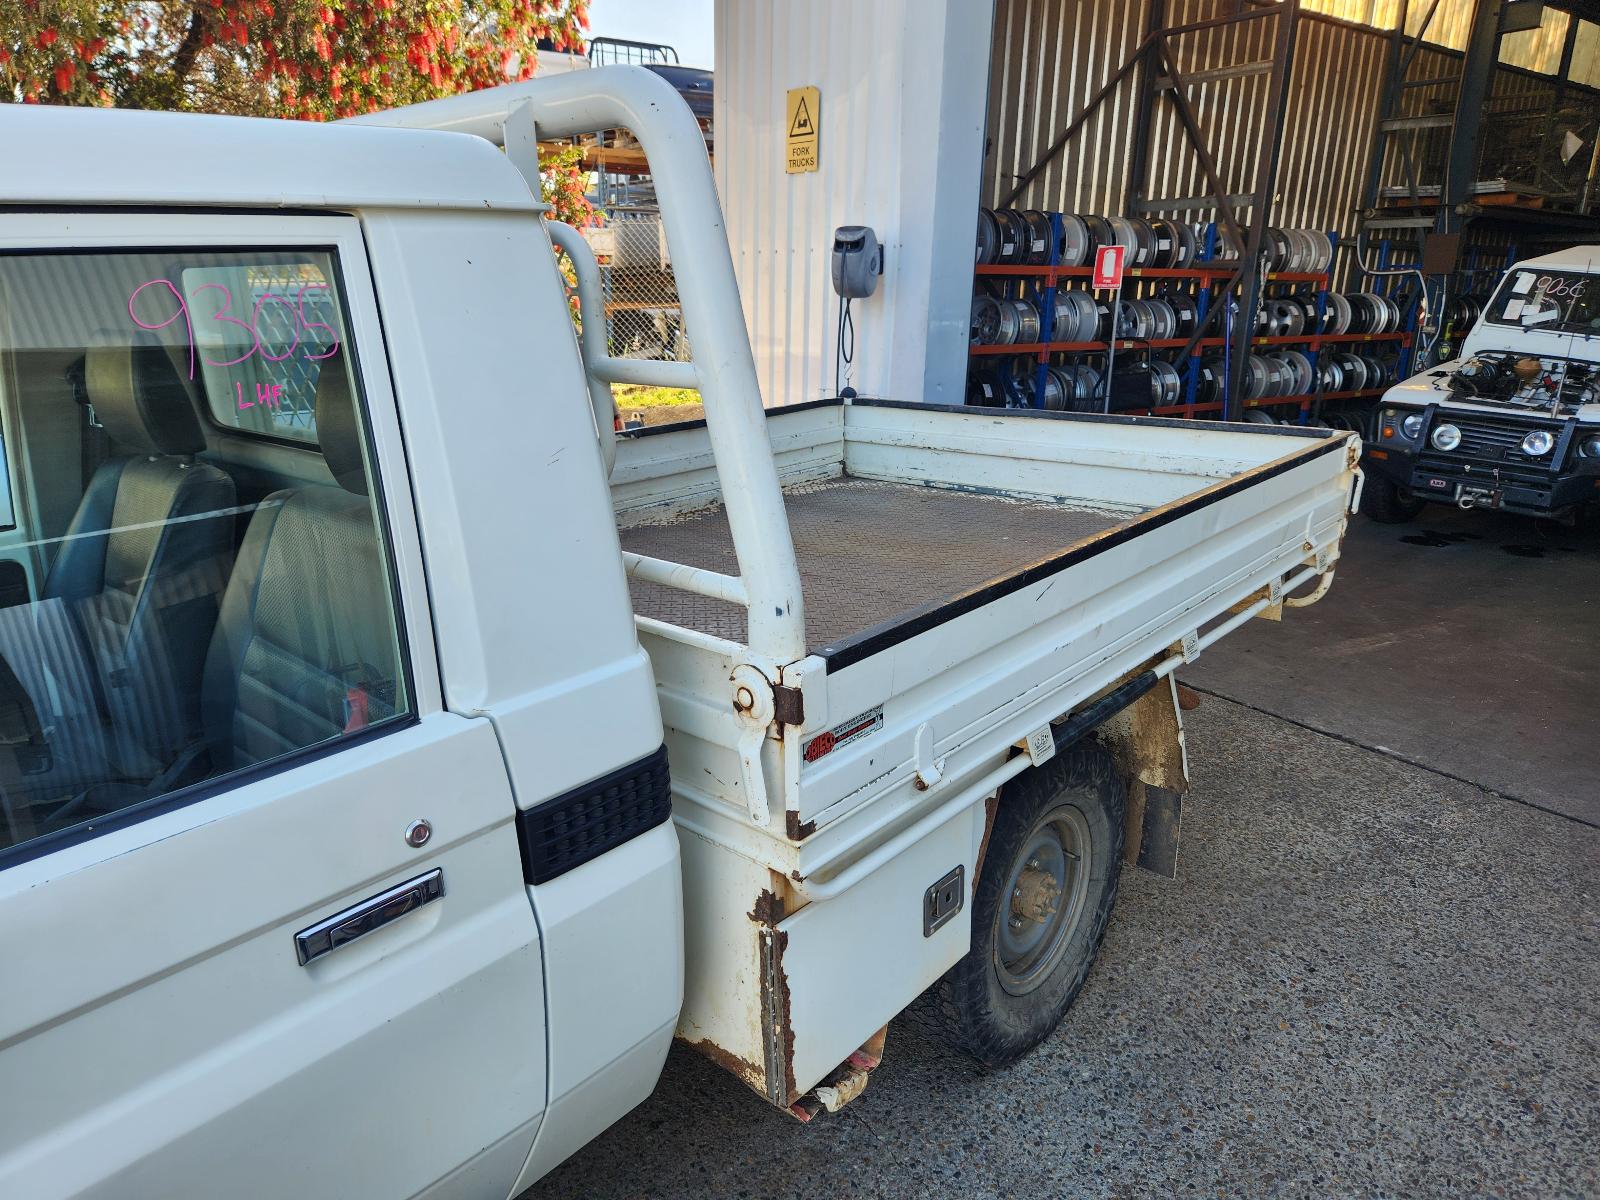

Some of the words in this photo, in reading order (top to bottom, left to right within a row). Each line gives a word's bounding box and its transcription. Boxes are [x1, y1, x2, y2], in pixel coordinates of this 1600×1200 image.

[792, 147, 810, 157] FORK
[788, 157, 815, 168] TRUCKS
[129, 279, 338, 380] 9305
[237, 382, 283, 409] LHF
